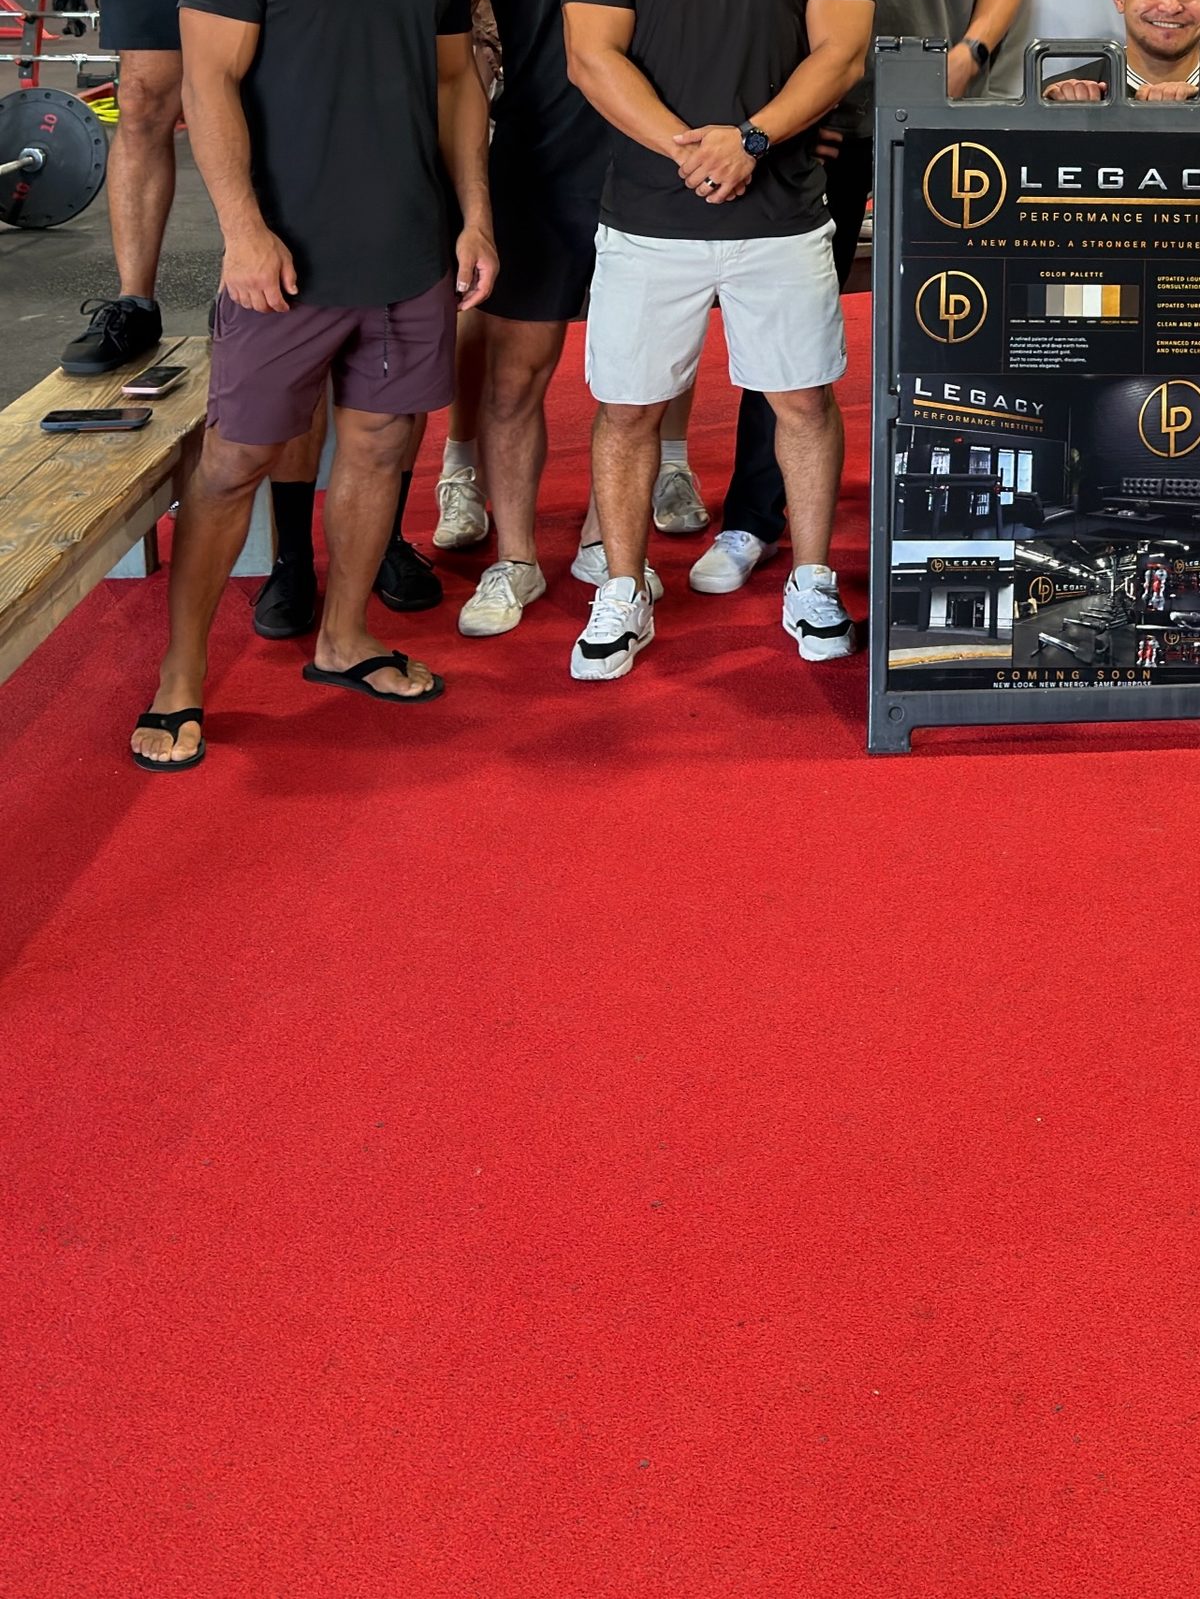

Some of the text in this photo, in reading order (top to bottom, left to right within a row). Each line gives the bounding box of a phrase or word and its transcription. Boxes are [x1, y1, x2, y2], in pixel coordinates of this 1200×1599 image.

[39, 113, 58, 133] 10
[1019, 212, 1143, 223] PERFORMANCE
[967, 239, 974, 247] A
[981, 239, 1007, 247] NEW
[1014, 239, 1060, 247] BRAND.
[1082, 240, 1147, 248] STRONGER
[915, 377, 1044, 415] LEGACY
[914, 409, 1044, 433] PERFORMANCE INSTITUTE
[1055, 584, 1088, 592] LEGACY
[996, 670, 1151, 680] COMING SOON
